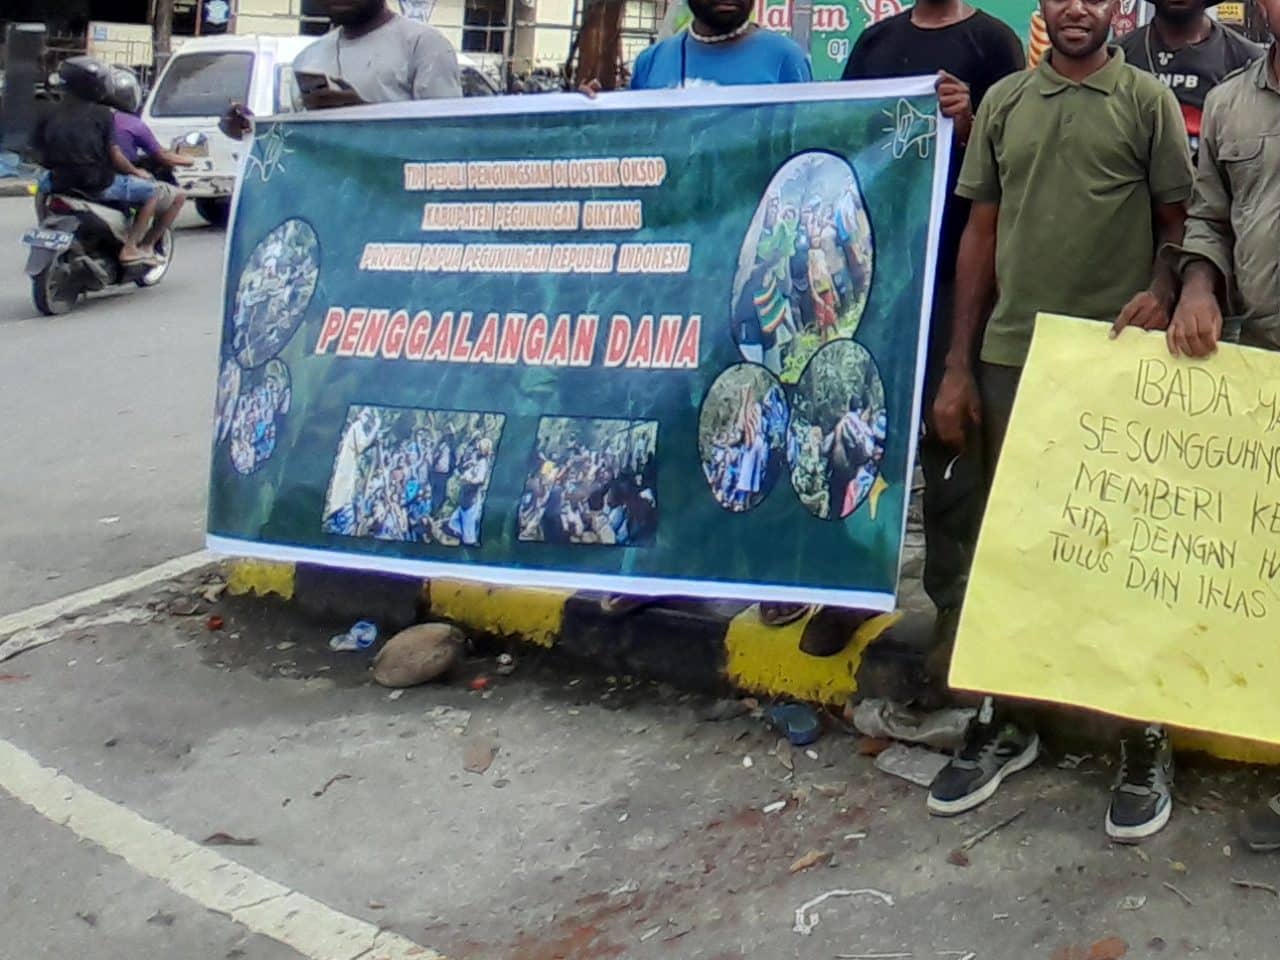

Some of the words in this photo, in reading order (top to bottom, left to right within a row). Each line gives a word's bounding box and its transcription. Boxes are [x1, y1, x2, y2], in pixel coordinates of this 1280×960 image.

[828, 38, 850, 58] 01
[1153, 73, 1199, 89] NPB
[569, 157, 621, 188] DISTRIK
[620, 156, 667, 187] OKSOP
[421, 202, 494, 231] KABUPATEN
[493, 200, 580, 231] PEGUNUNGAN
[581, 199, 643, 230] BINTANG
[616, 242, 693, 273] INDONESIA
[315, 306, 600, 367] PENGGALANGAN
[603, 313, 703, 369] DANA
[1134, 358, 1233, 417] IBADA
[1073, 461, 1223, 524] MEMBERI
[1061, 493, 1110, 546] KITA
[1128, 516, 1237, 570] DENGAN
[1048, 530, 1115, 574] TULUS
[1125, 554, 1181, 603] DAN
[1197, 574, 1267, 618] IKLAS
